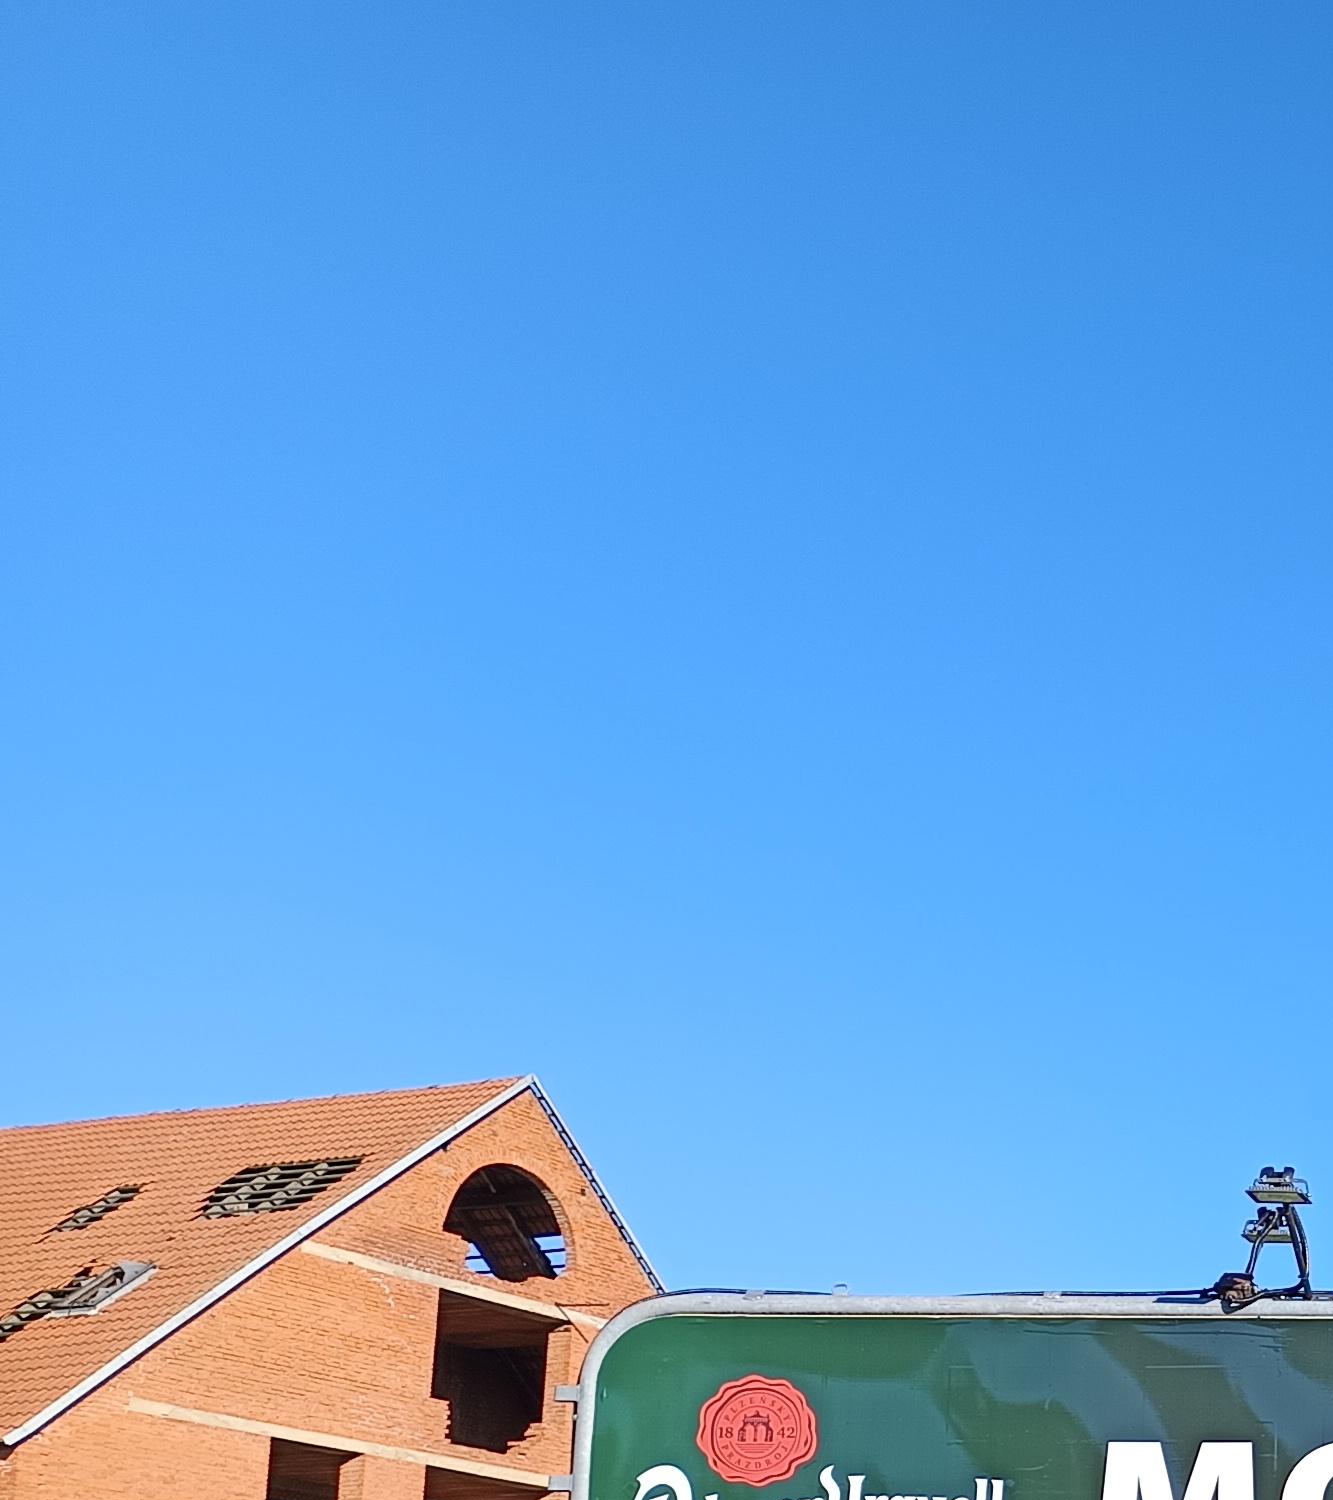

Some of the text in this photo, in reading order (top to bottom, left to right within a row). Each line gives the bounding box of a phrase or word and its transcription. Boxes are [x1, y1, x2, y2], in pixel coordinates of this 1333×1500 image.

[718, 1427, 796, 1439] 18 42
[721, 1444, 788, 1469] PRAZDROJ
